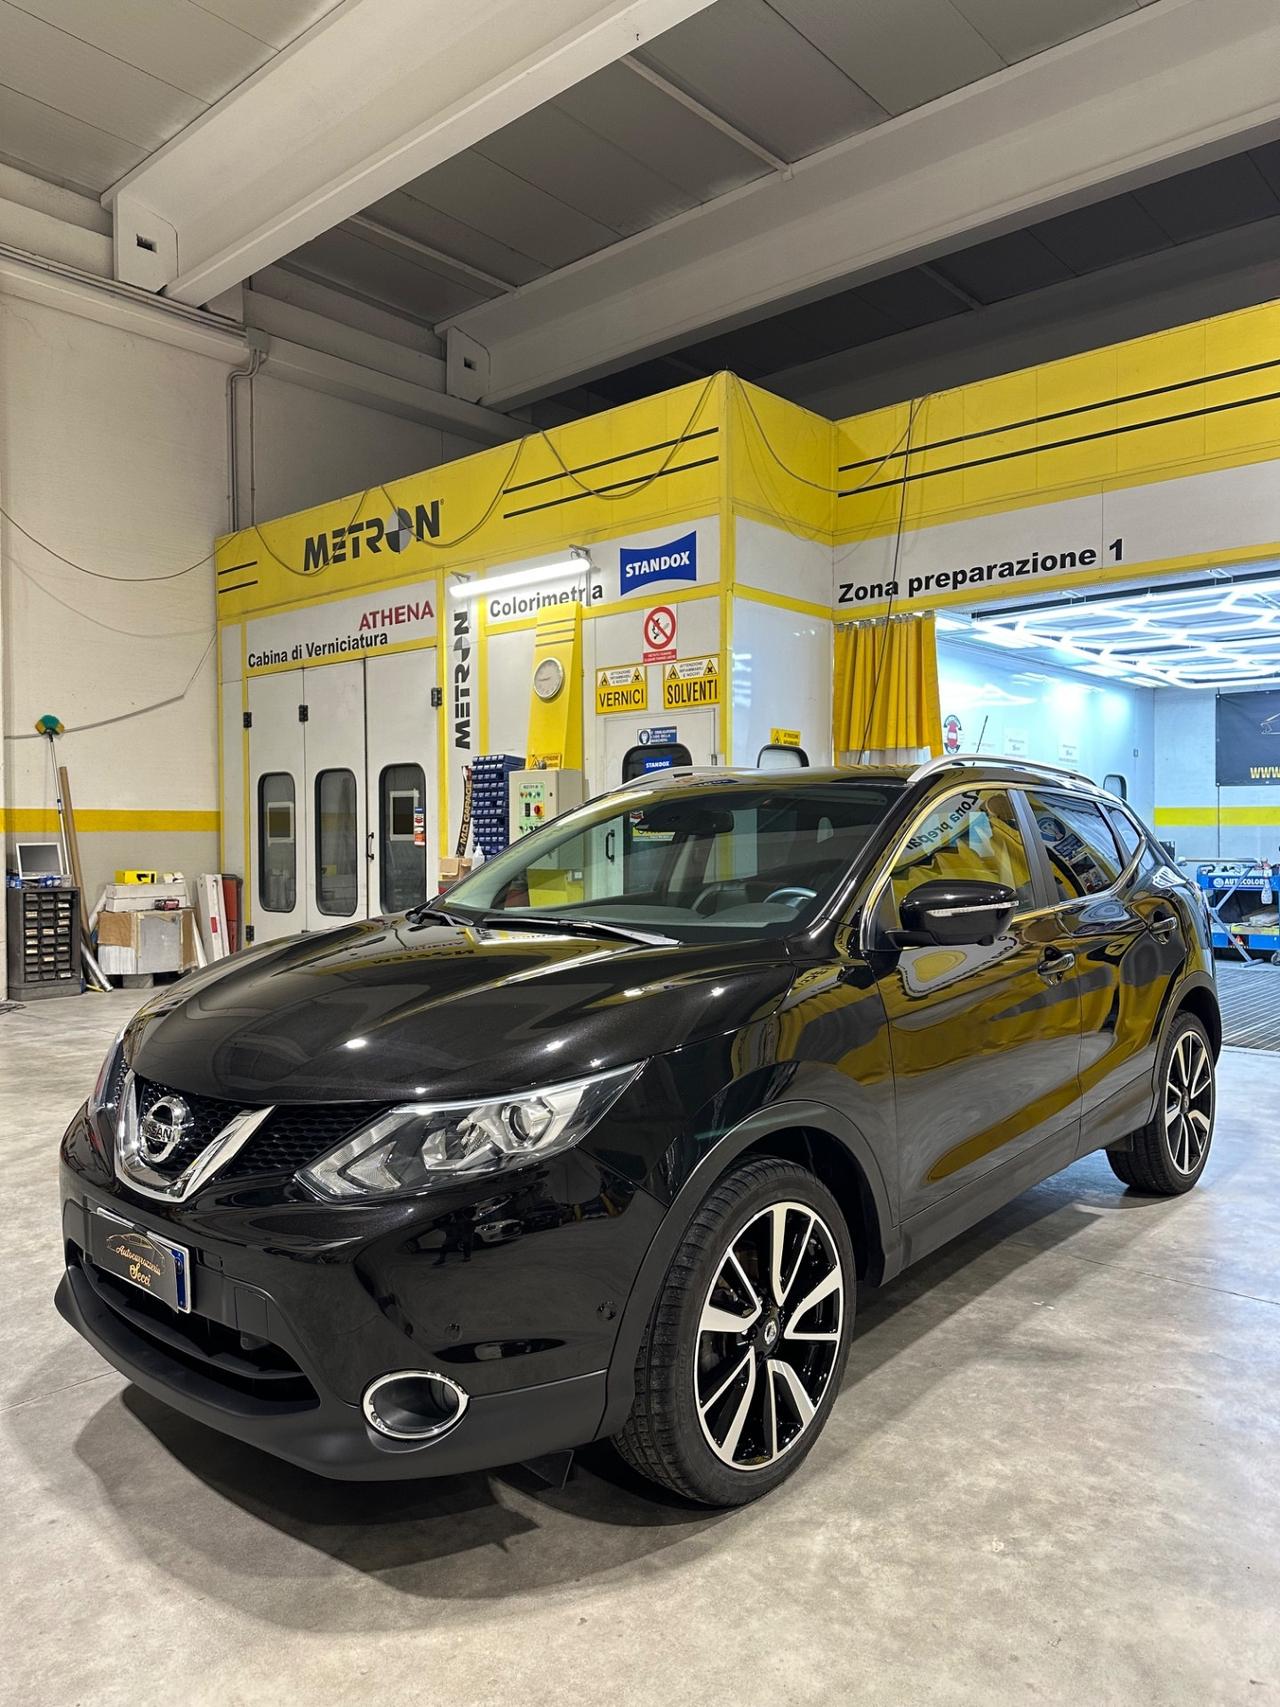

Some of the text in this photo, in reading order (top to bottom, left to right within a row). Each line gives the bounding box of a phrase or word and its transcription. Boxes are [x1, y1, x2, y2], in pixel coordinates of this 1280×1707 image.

[303, 500, 441, 571] METRON
[625, 550, 691, 578] STANDOX
[838, 538, 1124, 603] Zona preparazione 1
[359, 600, 435, 631] ATHENA
[490, 584, 603, 617] Colorimetra
[248, 631, 389, 668] Cabina di Verniciatura
[454, 610, 471, 750] METRON
[667, 679, 717, 704] SOLVENTI
[599, 688, 644, 708] VERNICI
[645, 760, 670, 768] STANDOX
[1224, 878, 1265, 886] AUTCOLOR
